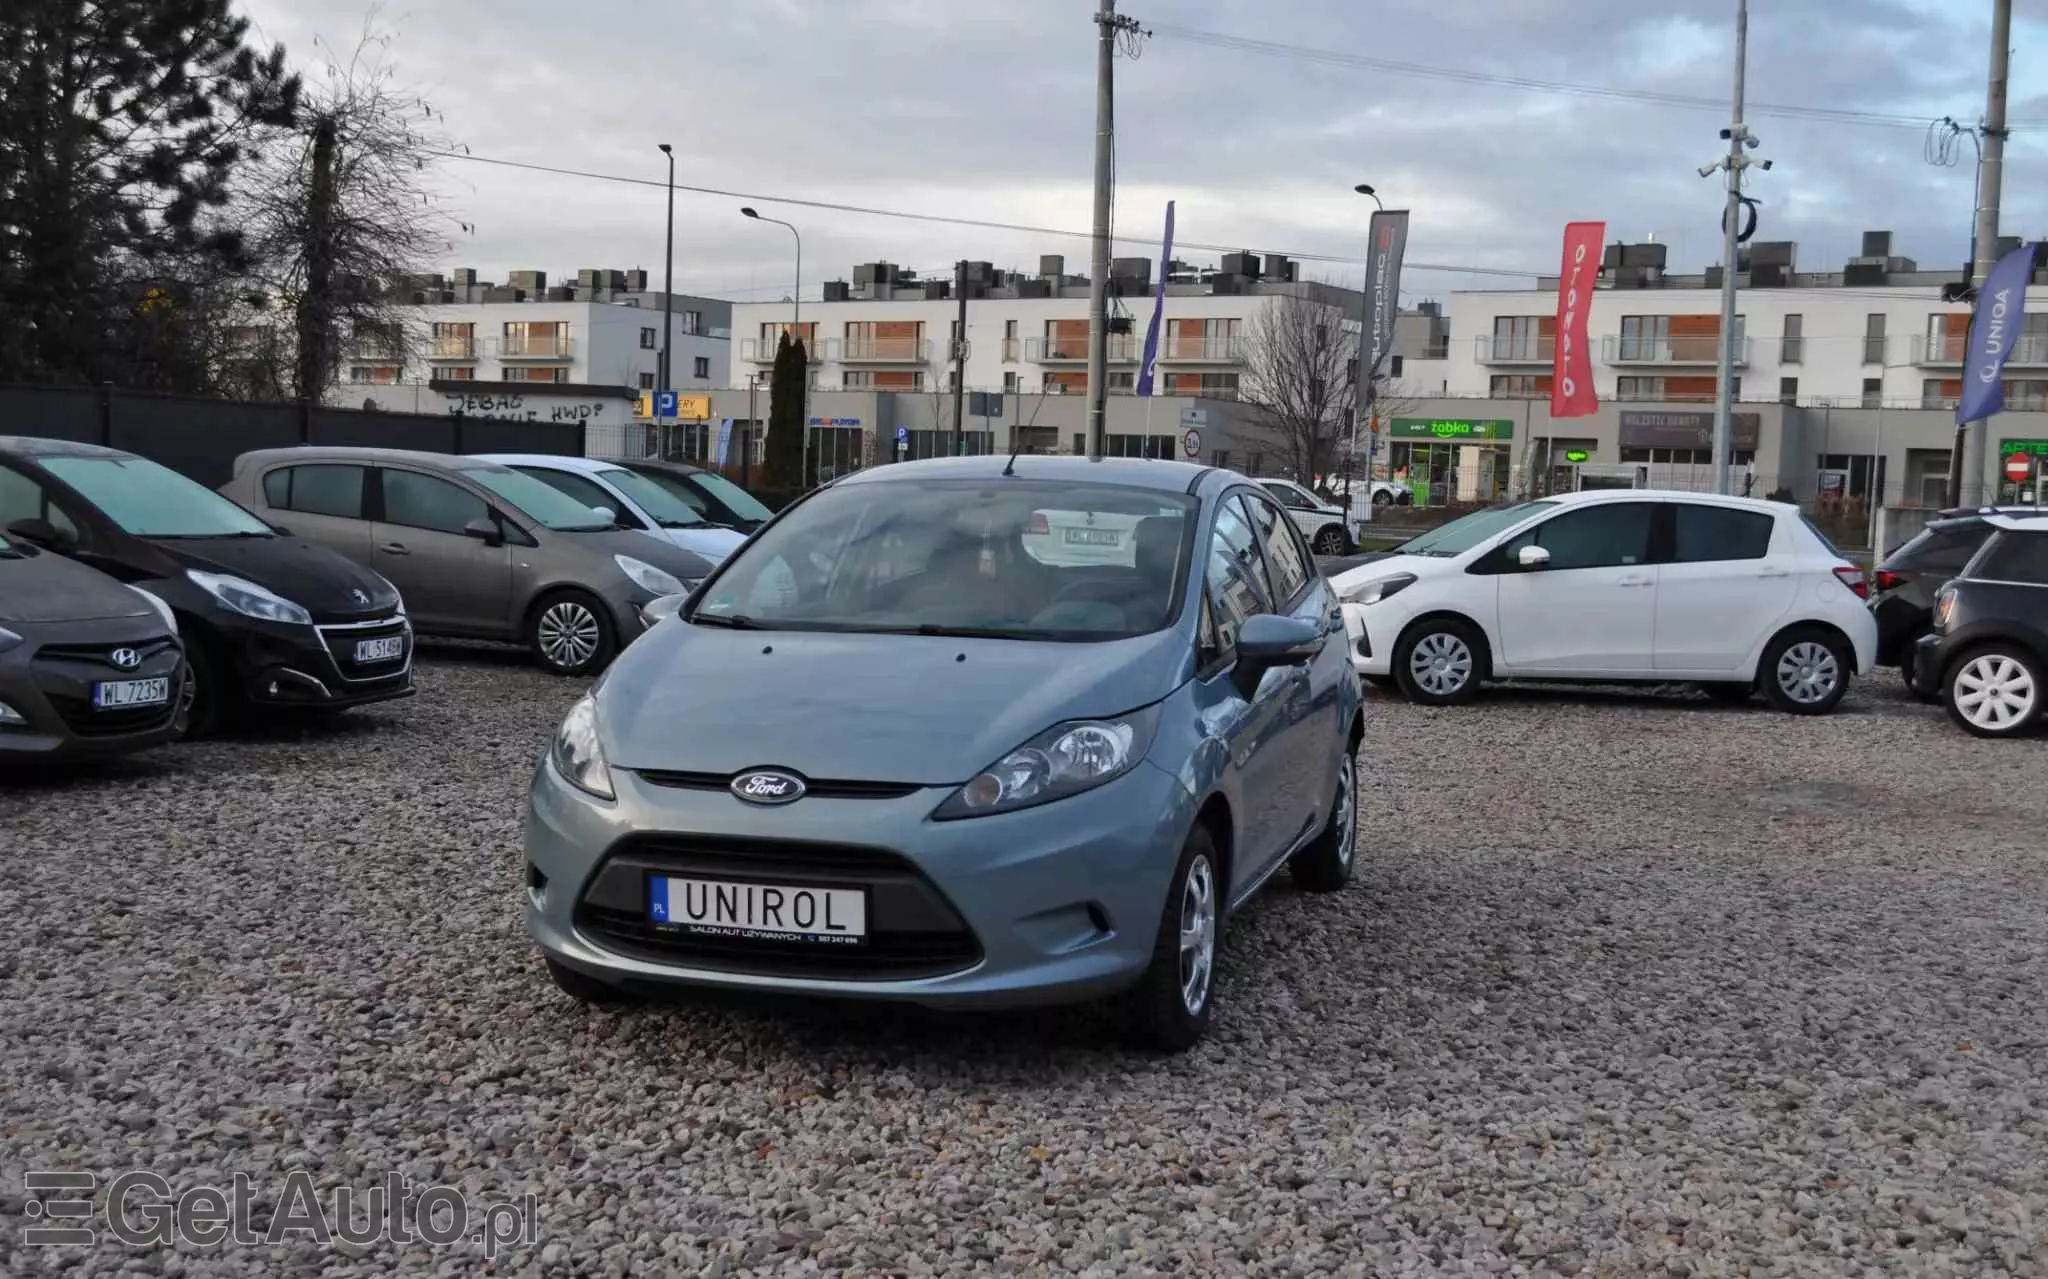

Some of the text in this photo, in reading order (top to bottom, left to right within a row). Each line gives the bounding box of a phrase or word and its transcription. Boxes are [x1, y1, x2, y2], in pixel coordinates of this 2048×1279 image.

[1985, 288, 2011, 355] UNIQA
[1431, 420, 1469, 433] żabka
[104, 684, 122, 704] WL
[746, 776, 788, 795] Ford
[654, 903, 665, 914] PL
[686, 882, 846, 931] UNIROL
[689, 925, 721, 934] SALON
[722, 927, 739, 936] AUT
